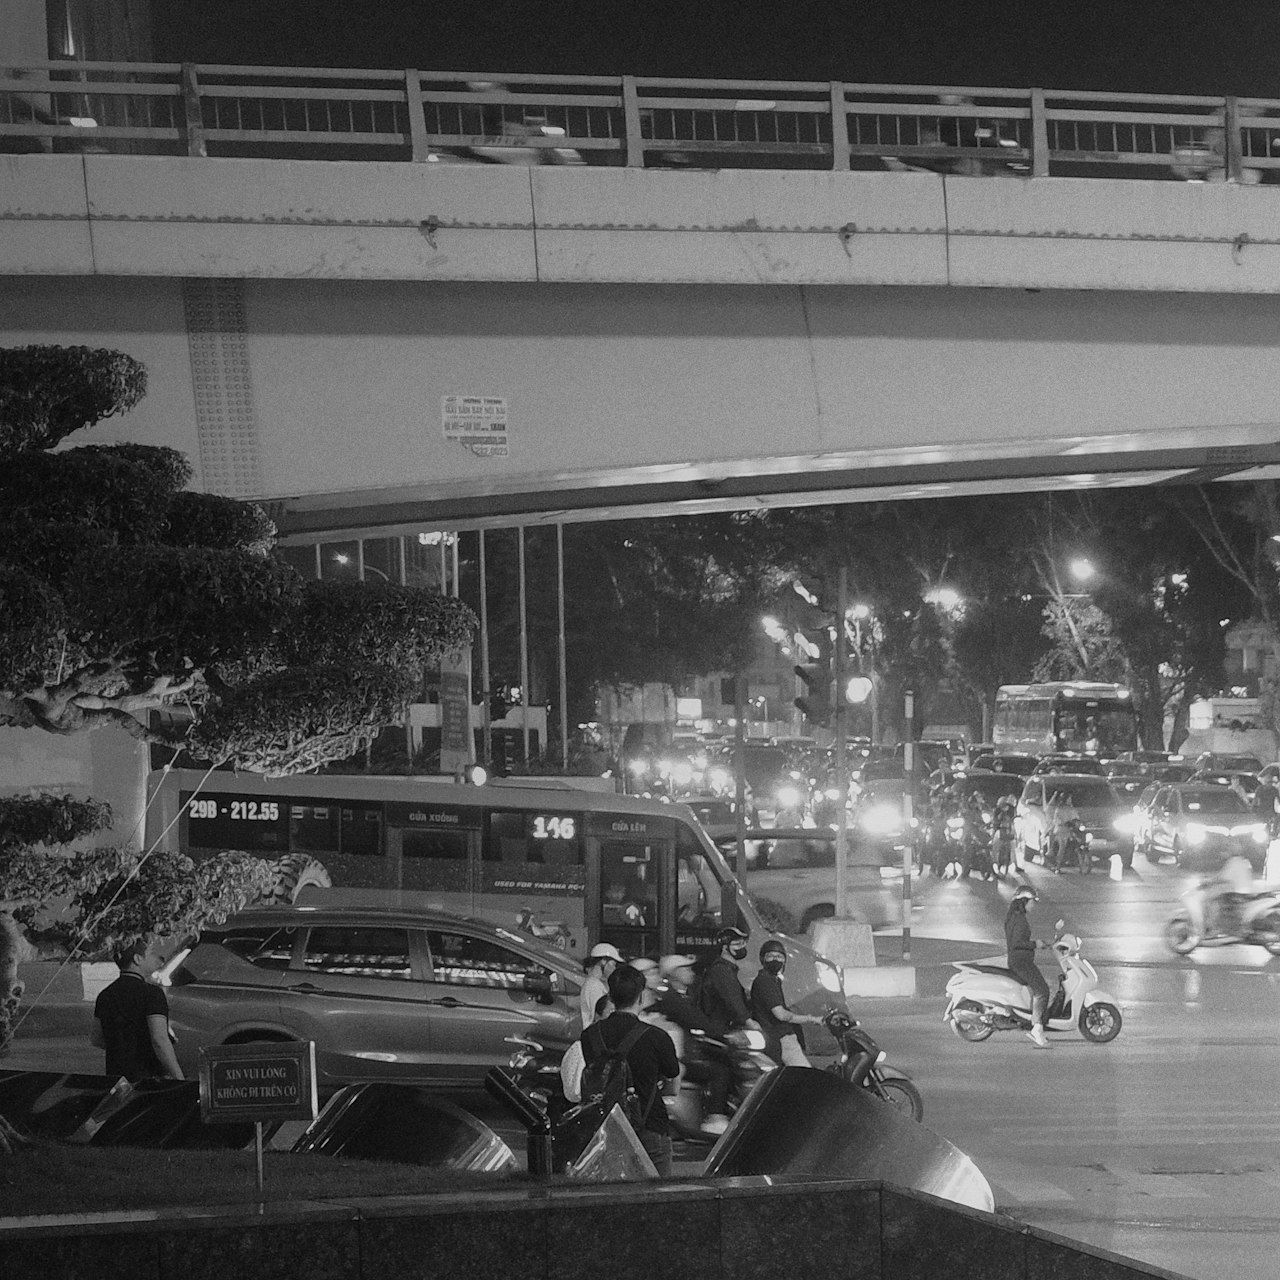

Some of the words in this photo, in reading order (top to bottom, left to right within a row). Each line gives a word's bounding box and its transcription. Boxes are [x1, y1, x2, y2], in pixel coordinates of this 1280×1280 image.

[189, 799, 218, 819] 29B
[230, 801, 279, 821] 212.55
[226, 1068, 242, 1080] XIN
[243, 1068, 259, 1079] VUI
[217, 1085, 248, 1099] KHÔNG
[260, 1083, 282, 1097] TRÊN
